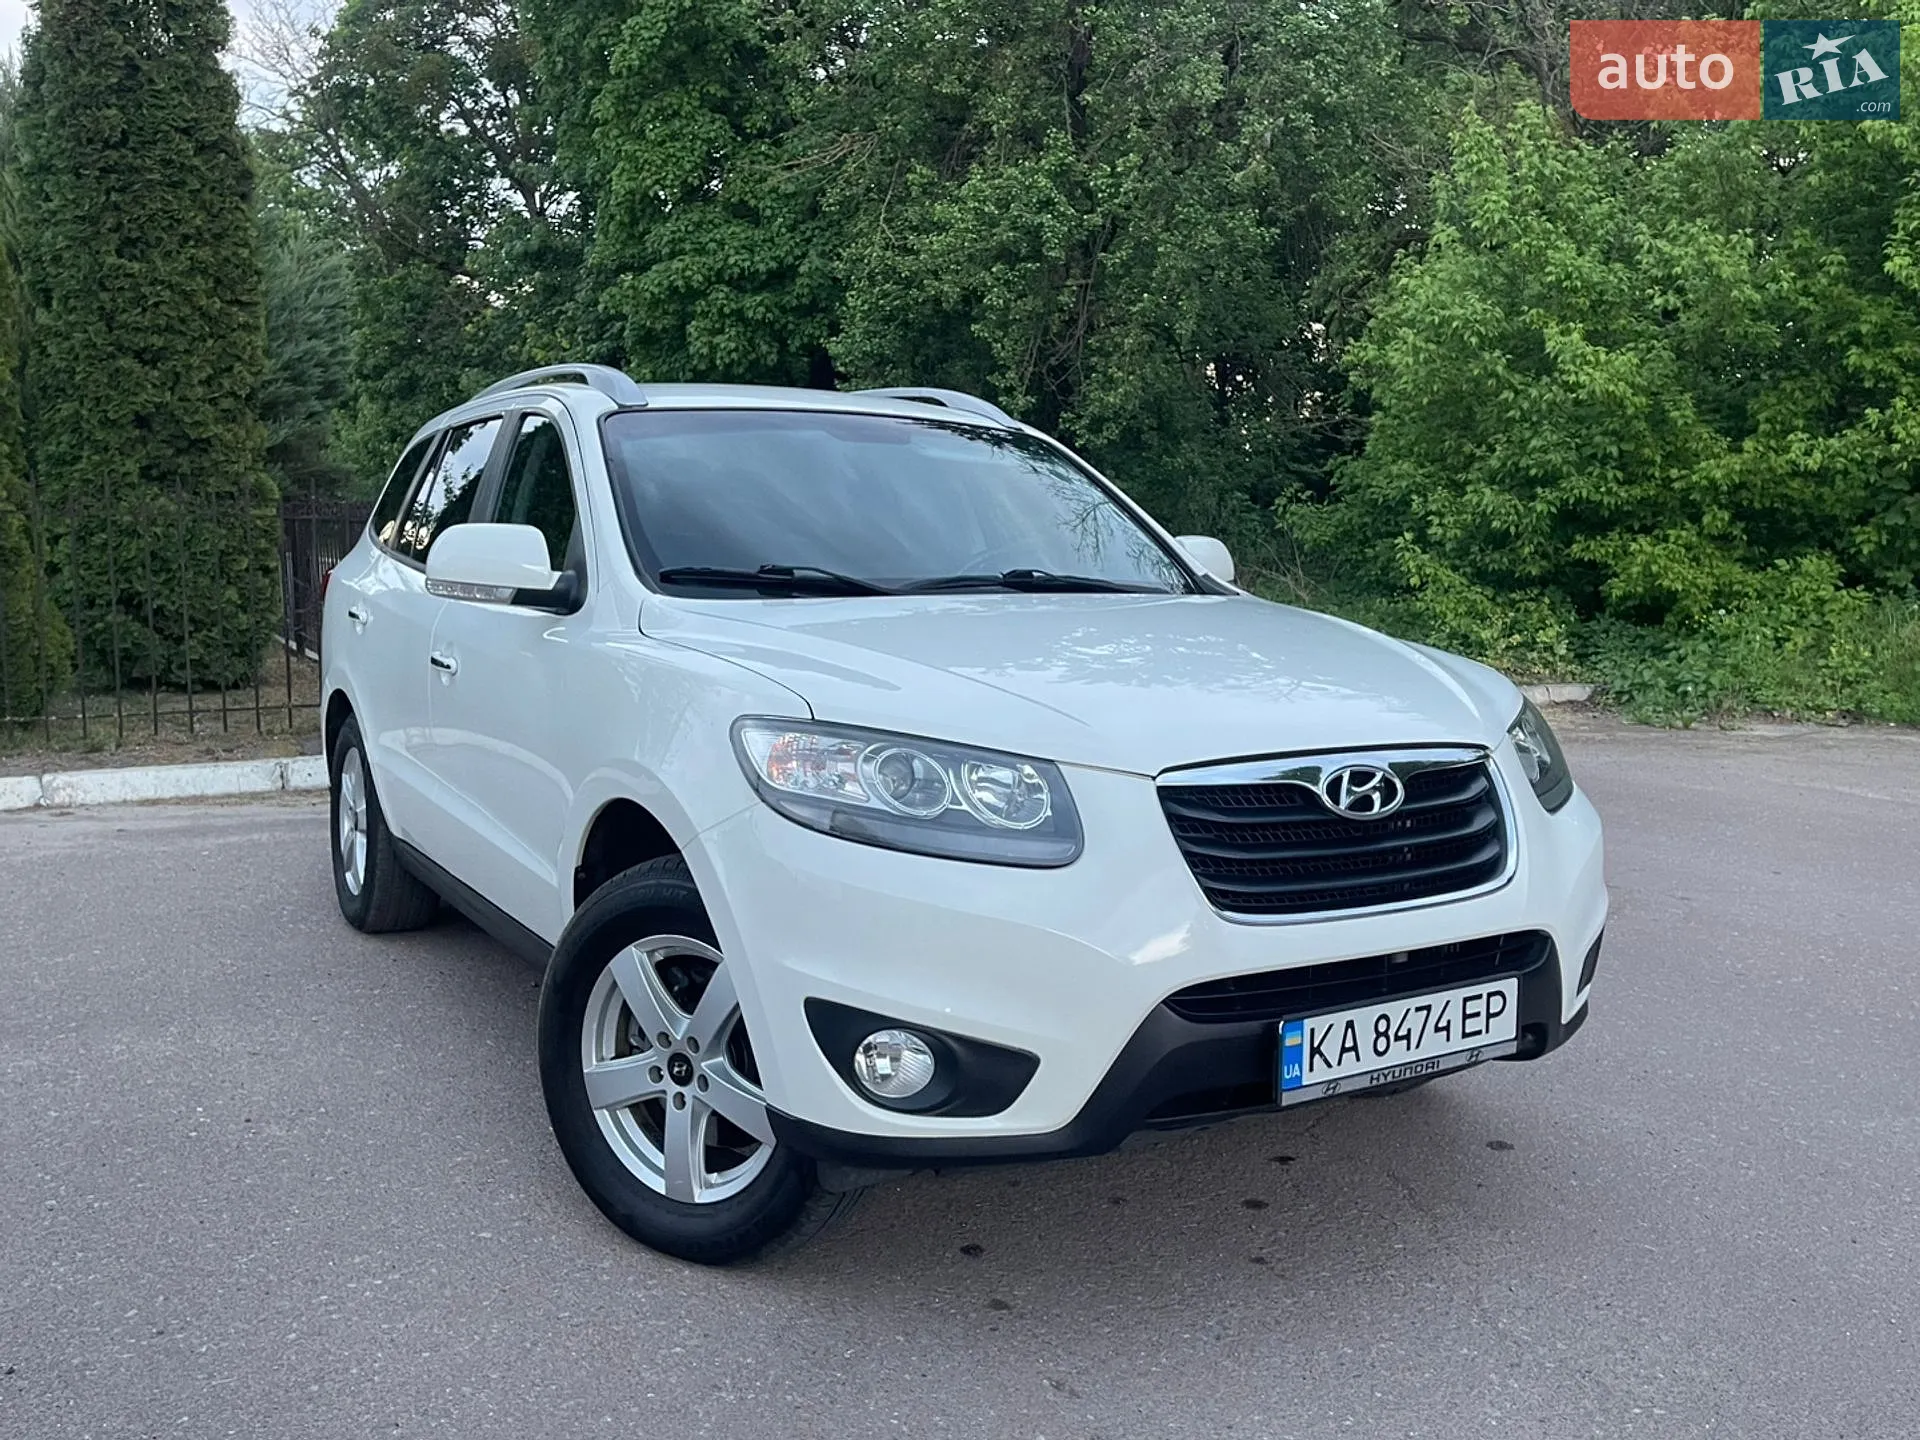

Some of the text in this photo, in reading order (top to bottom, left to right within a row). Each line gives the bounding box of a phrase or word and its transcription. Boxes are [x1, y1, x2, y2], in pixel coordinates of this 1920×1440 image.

[1308, 990, 1508, 1073] KA 8474 EP
[1283, 1062, 1301, 1080] UA
[1369, 1059, 1440, 1085] HYUNDAI
